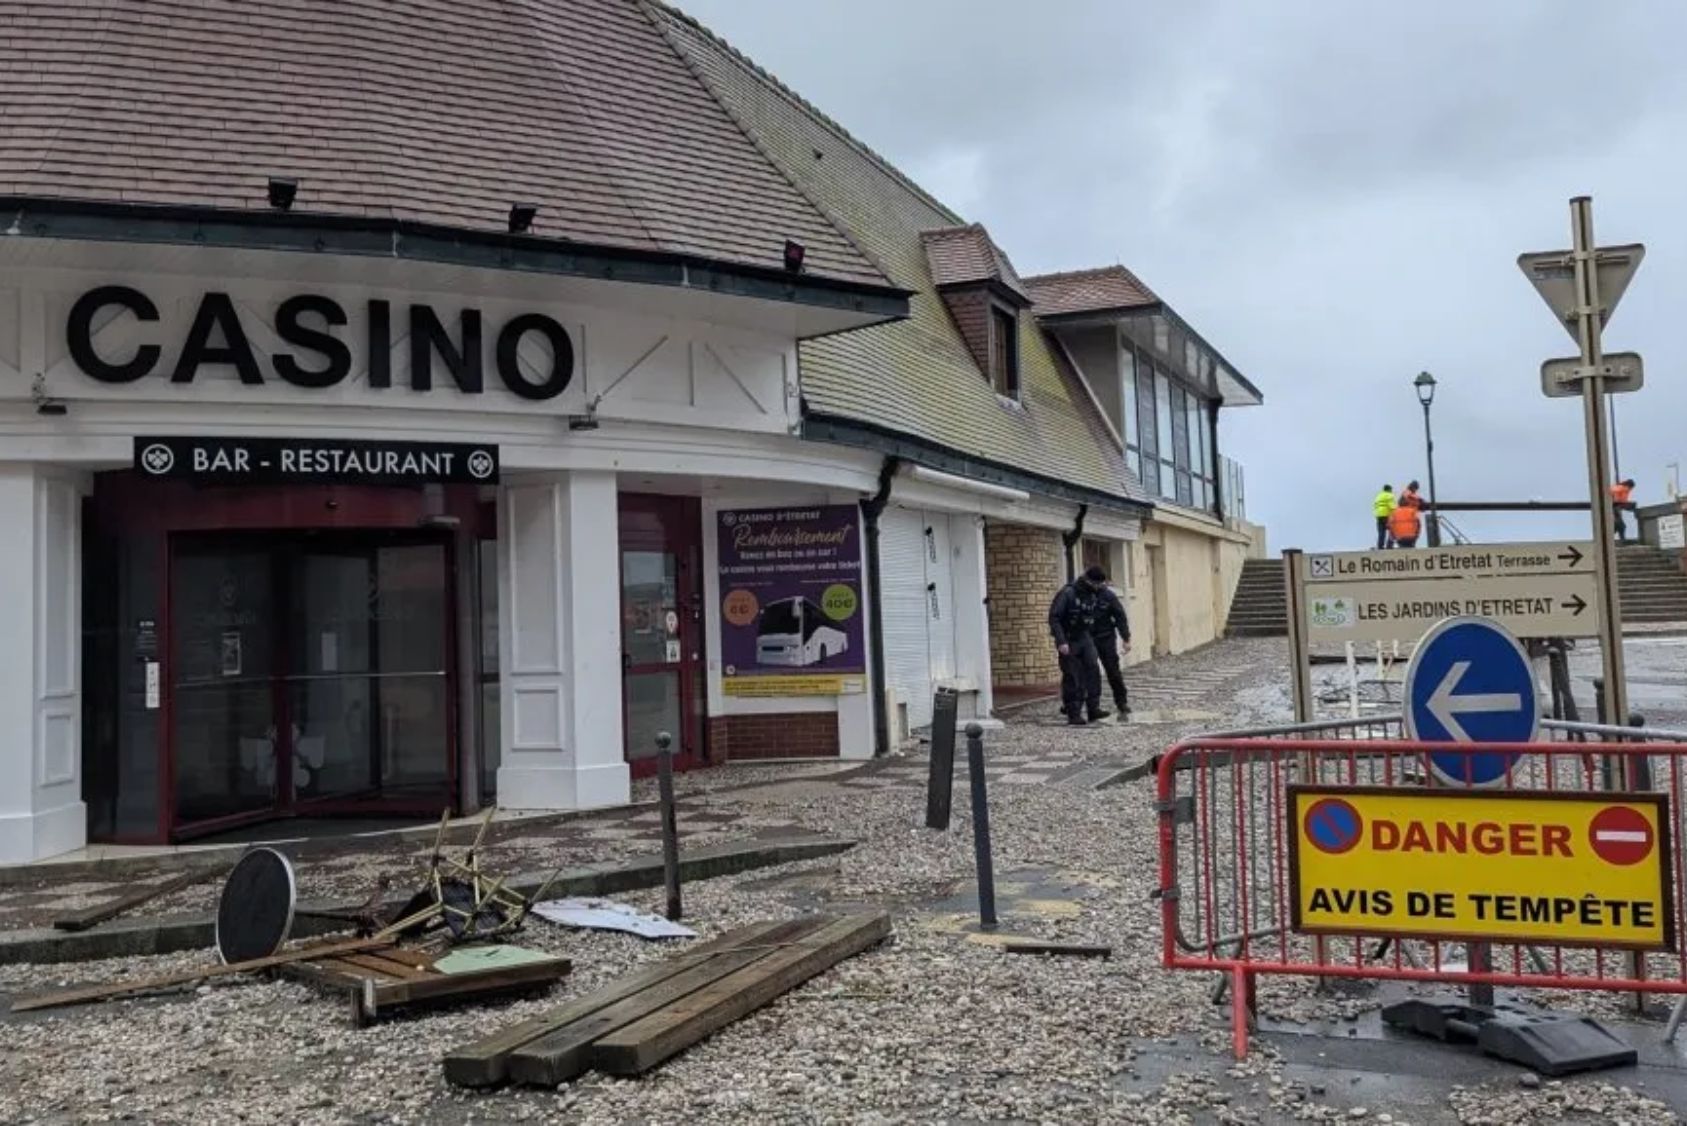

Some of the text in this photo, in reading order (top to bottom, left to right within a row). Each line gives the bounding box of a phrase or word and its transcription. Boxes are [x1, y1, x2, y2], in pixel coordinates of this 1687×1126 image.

[67, 285, 574, 400] CASINO
[194, 448, 250, 472] BAR
[281, 449, 454, 475] RESTAURANT
[1339, 554, 1551, 574] Le Romain d'Etretat Terrasse
[1358, 603, 1388, 620] LES
[1392, 600, 1461, 619] JARDINS
[1465, 598, 1553, 615] D'ETRETAT
[1371, 820, 1574, 857] DANGER
[1309, 888, 1656, 928] AVIS DE TEMPÊTE
